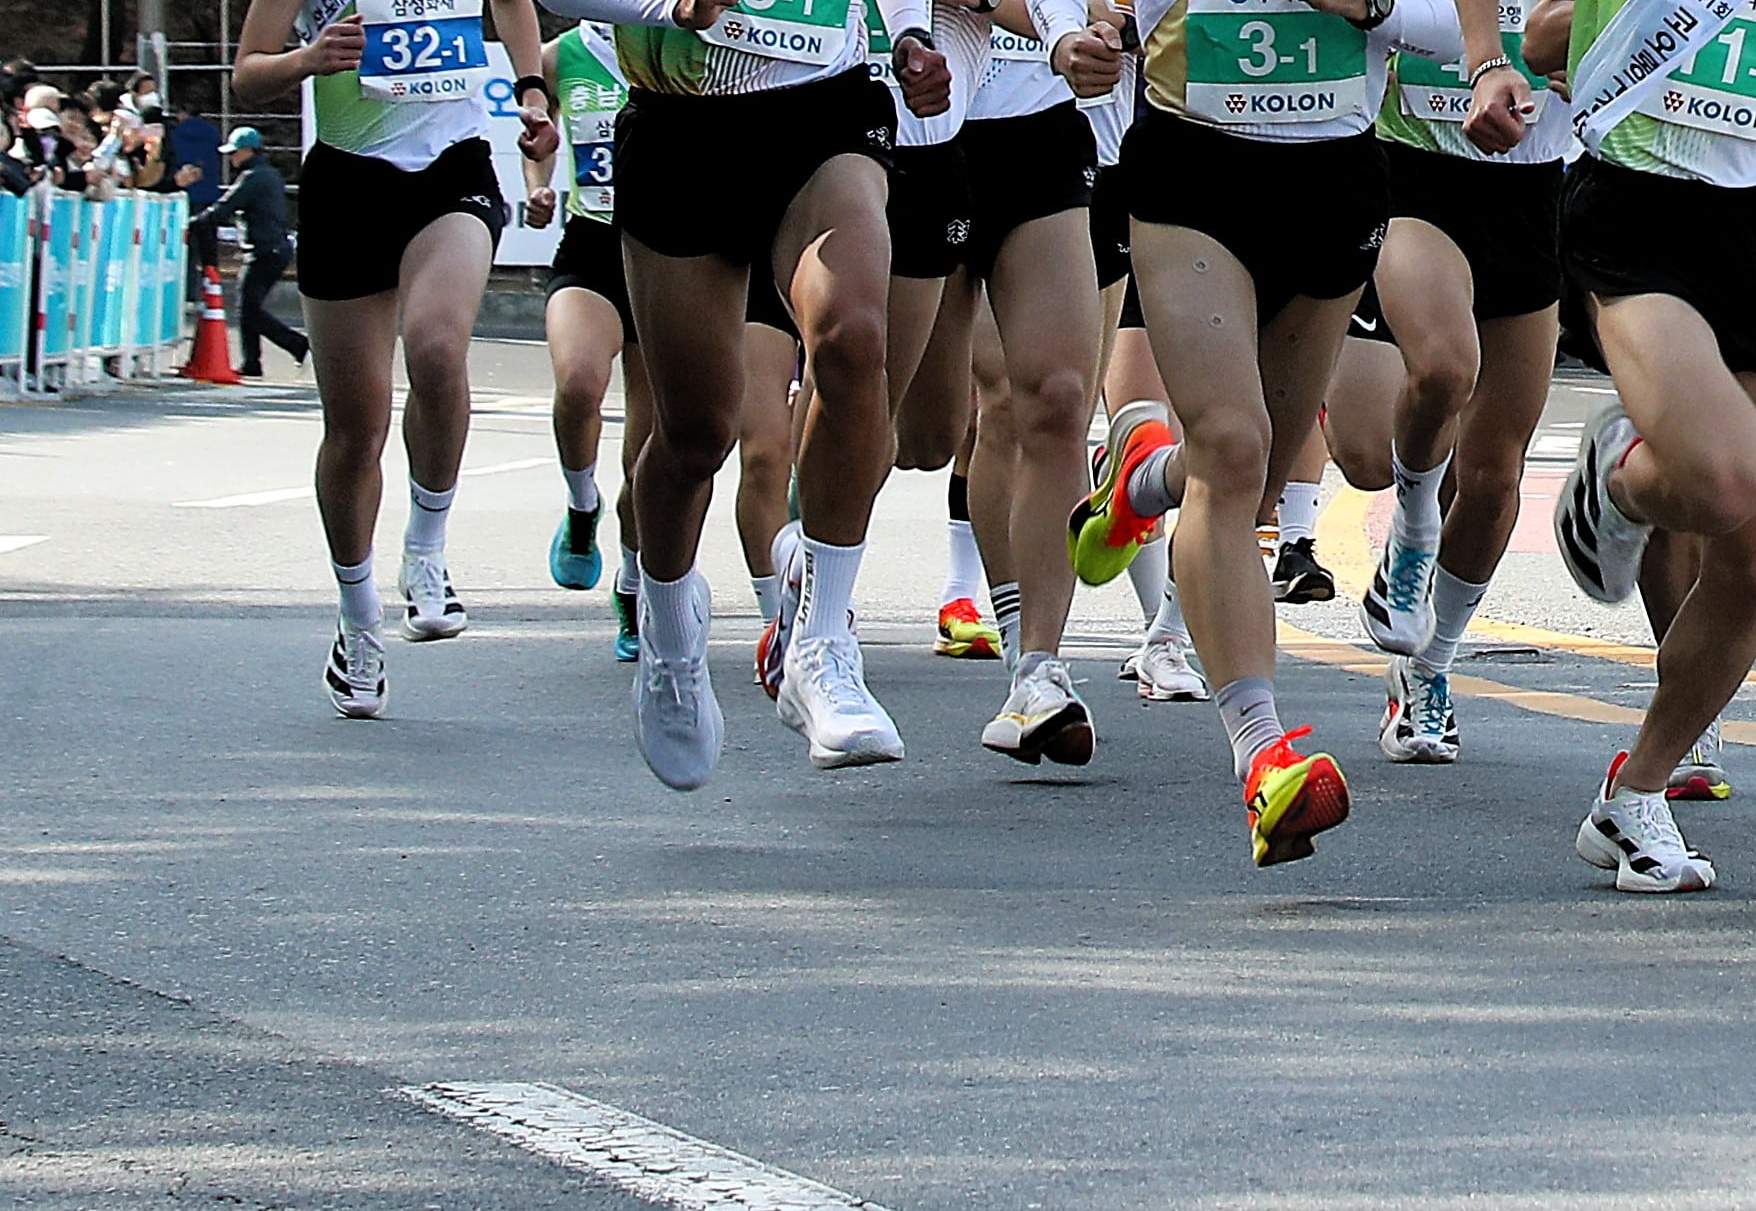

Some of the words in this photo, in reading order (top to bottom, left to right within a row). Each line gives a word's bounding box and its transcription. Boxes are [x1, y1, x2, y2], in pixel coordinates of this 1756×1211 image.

[382, 25, 467, 71] 32-1
[747, 28, 823, 55] KOLON
[1238, 21, 1319, 77] 3-1
[410, 78, 467, 96] KOLON
[1251, 93, 1335, 113] KOLON
